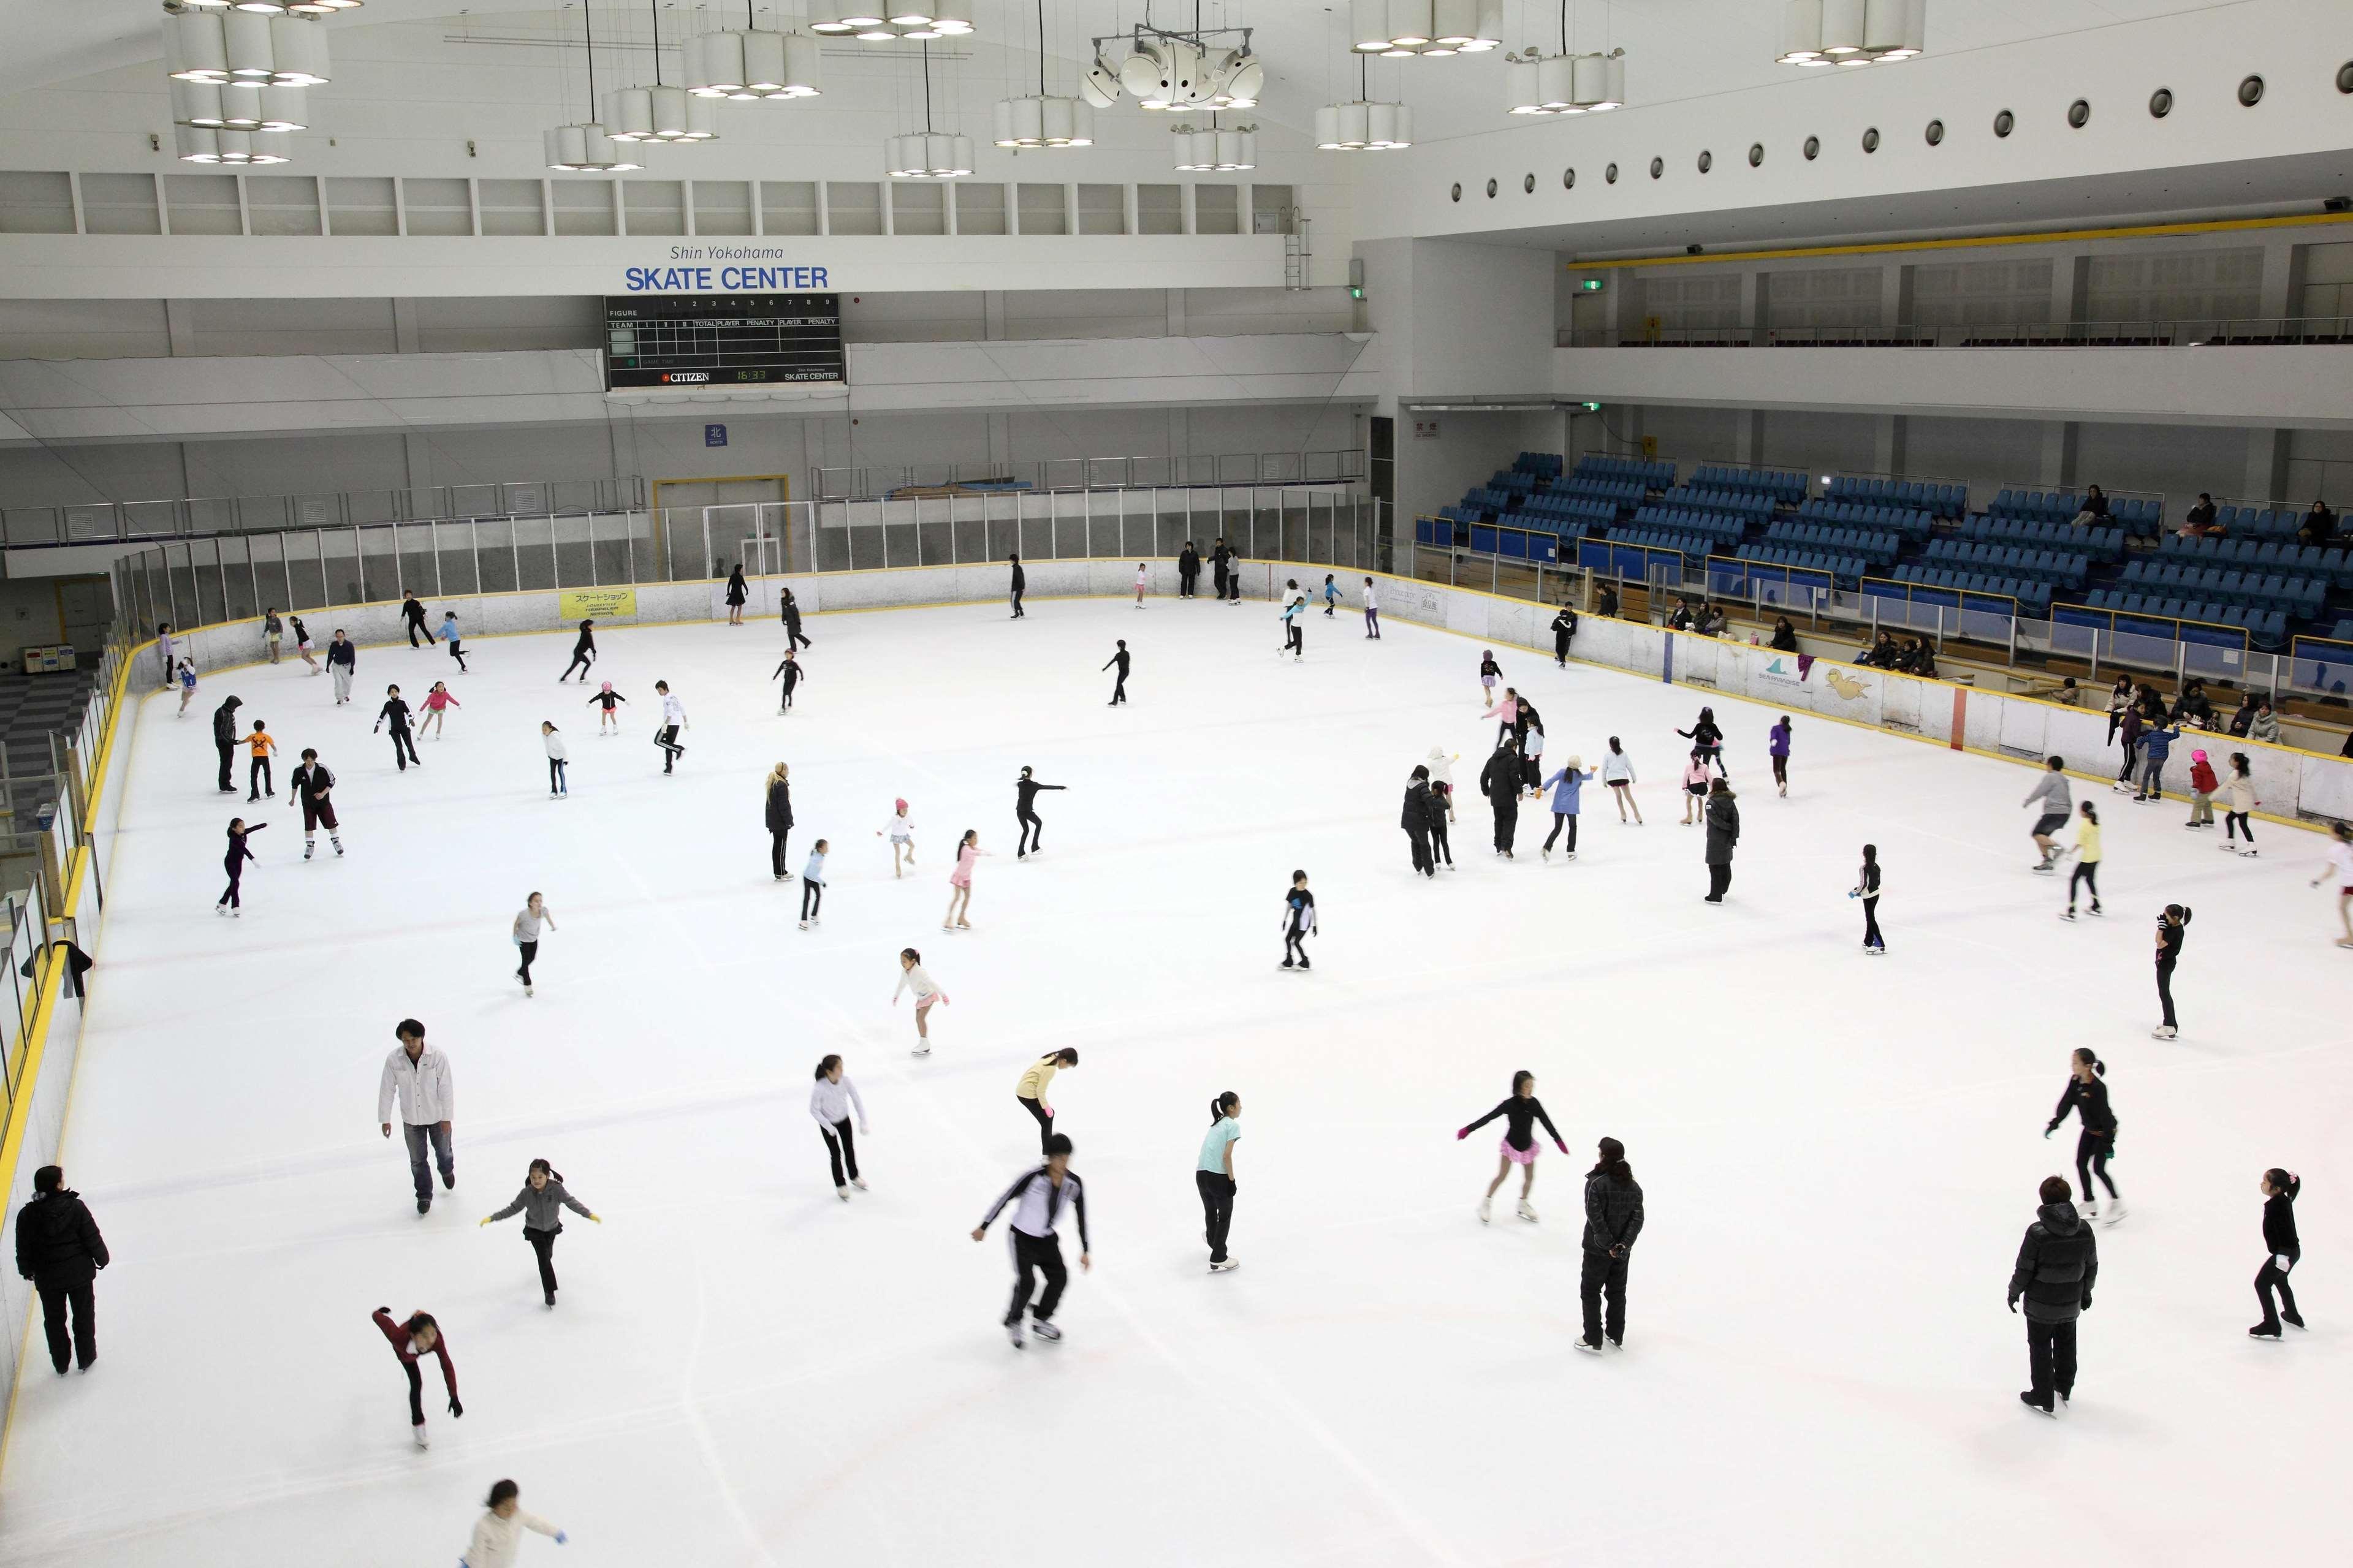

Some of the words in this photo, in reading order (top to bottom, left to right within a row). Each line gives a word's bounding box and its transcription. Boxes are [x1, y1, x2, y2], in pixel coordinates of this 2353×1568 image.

[671, 246, 702, 259] Shin
[708, 246, 783, 259] Yokohama
[625, 267, 713, 291] SKATE
[721, 267, 829, 290] CENTER
[670, 373, 709, 382] CITIZEN
[737, 371, 765, 380] 16:33
[711, 426, 721, 438] 北
[1771, 676, 1800, 686] PARADISE
